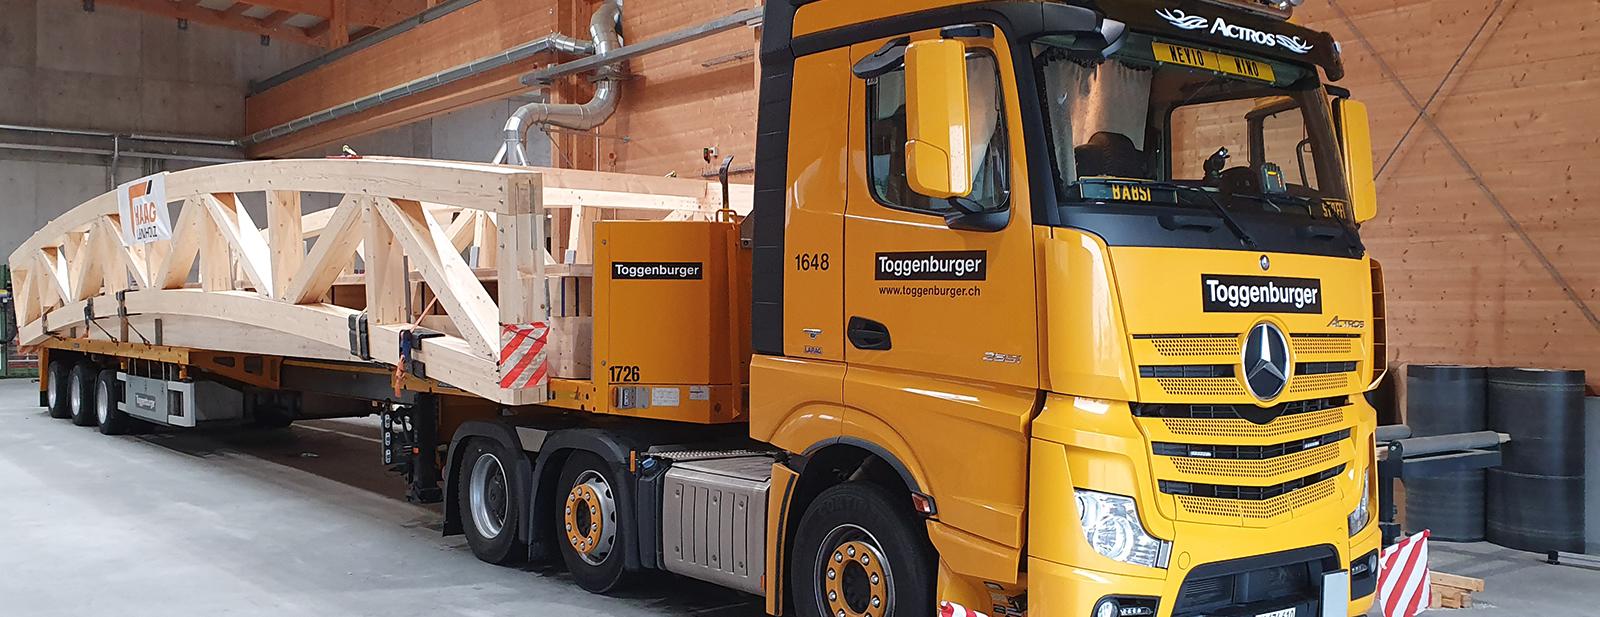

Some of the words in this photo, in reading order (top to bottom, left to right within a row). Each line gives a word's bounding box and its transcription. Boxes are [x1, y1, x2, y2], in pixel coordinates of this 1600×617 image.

[1209, 17, 1276, 47] ACTROS
[1169, 45, 1204, 66] NEVIO
[1234, 57, 1259, 77] NINO
[1112, 184, 1151, 202] BABSI
[134, 202, 157, 225] HAAG
[614, 264, 699, 278] Toggenburger
[795, 253, 830, 271] 1648
[878, 255, 982, 277] Toggenburger
[879, 285, 981, 298] www.toggenburger.ch
[1206, 279, 1318, 309] Toggenburger
[609, 365, 640, 382] 1726
